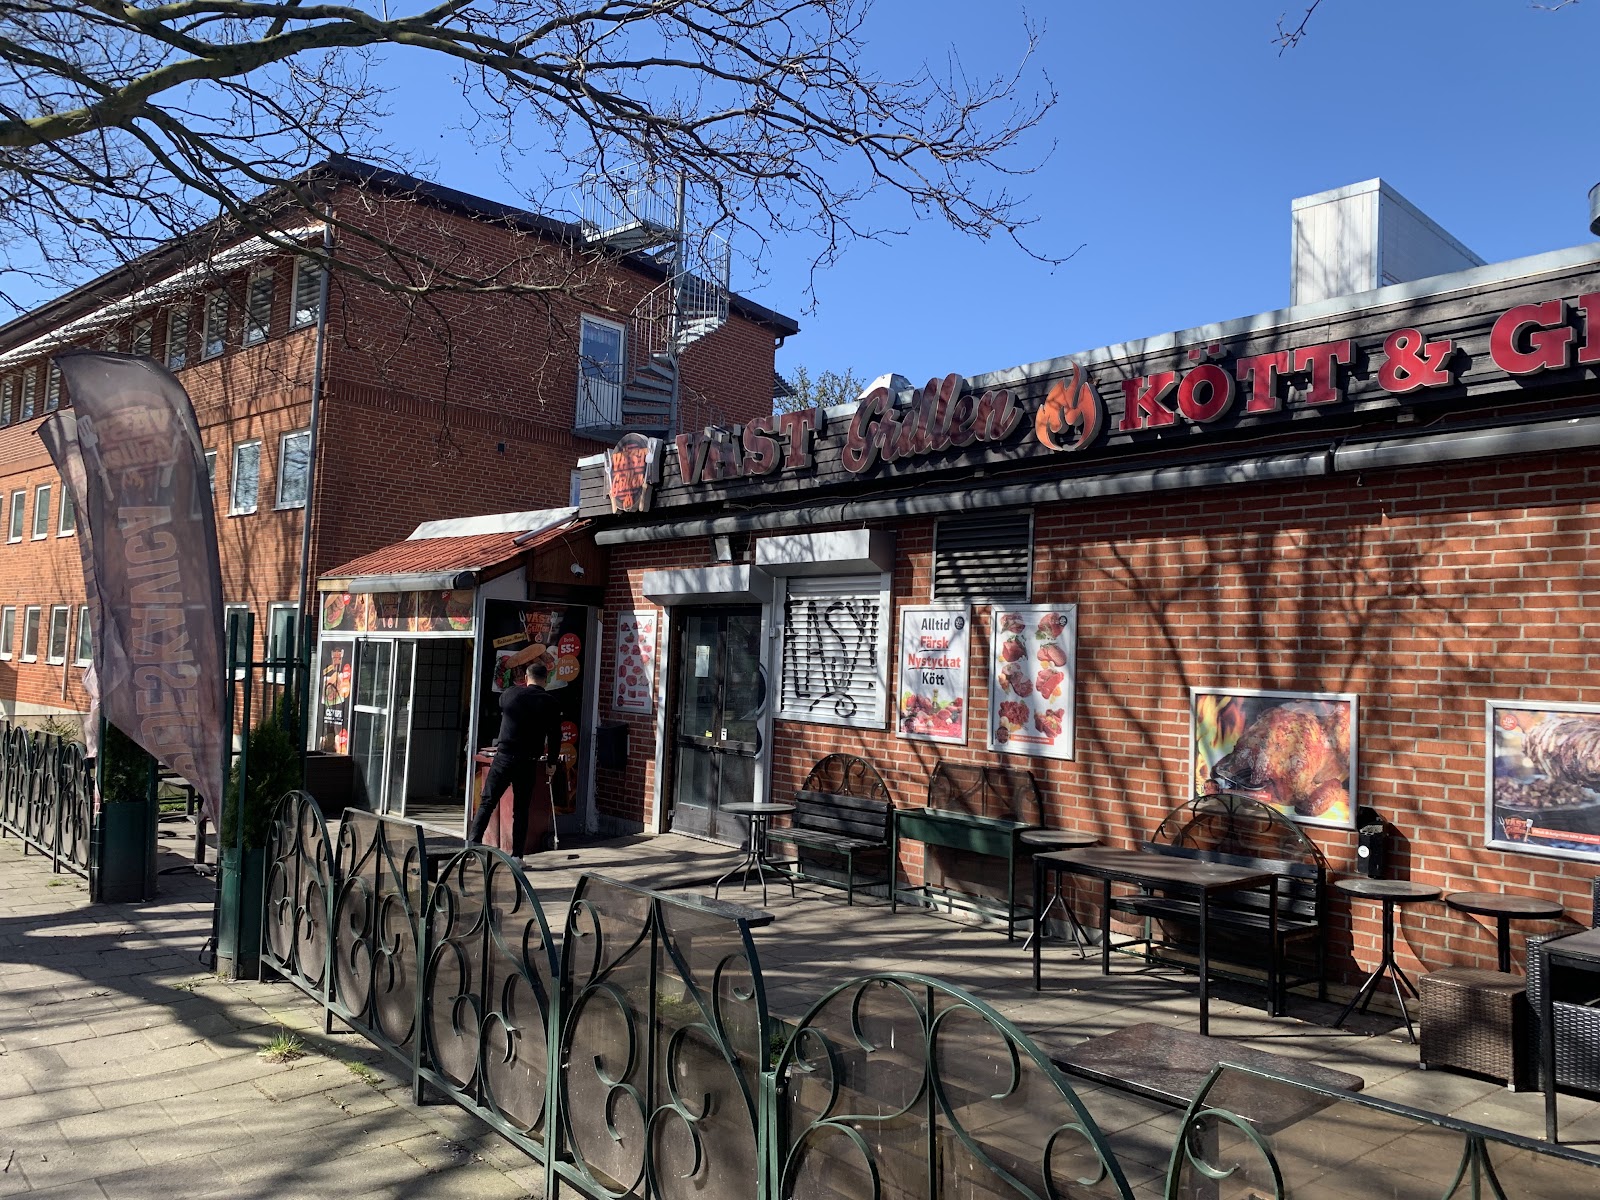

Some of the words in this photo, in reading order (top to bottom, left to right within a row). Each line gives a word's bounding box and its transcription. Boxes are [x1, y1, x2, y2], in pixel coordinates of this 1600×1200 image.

[675, 409, 822, 485] VÄST
[841, 373, 1022, 473] Grillen
[1119, 339, 1352, 432] KÖTT
[1378, 328, 1453, 393] &
[1490, 293, 1600, 374] G
[921, 618, 950, 631] Alltid
[920, 636, 949, 649] Färsk
[908, 654, 961, 670] Nystyckat
[922, 672, 944, 686] Kött
